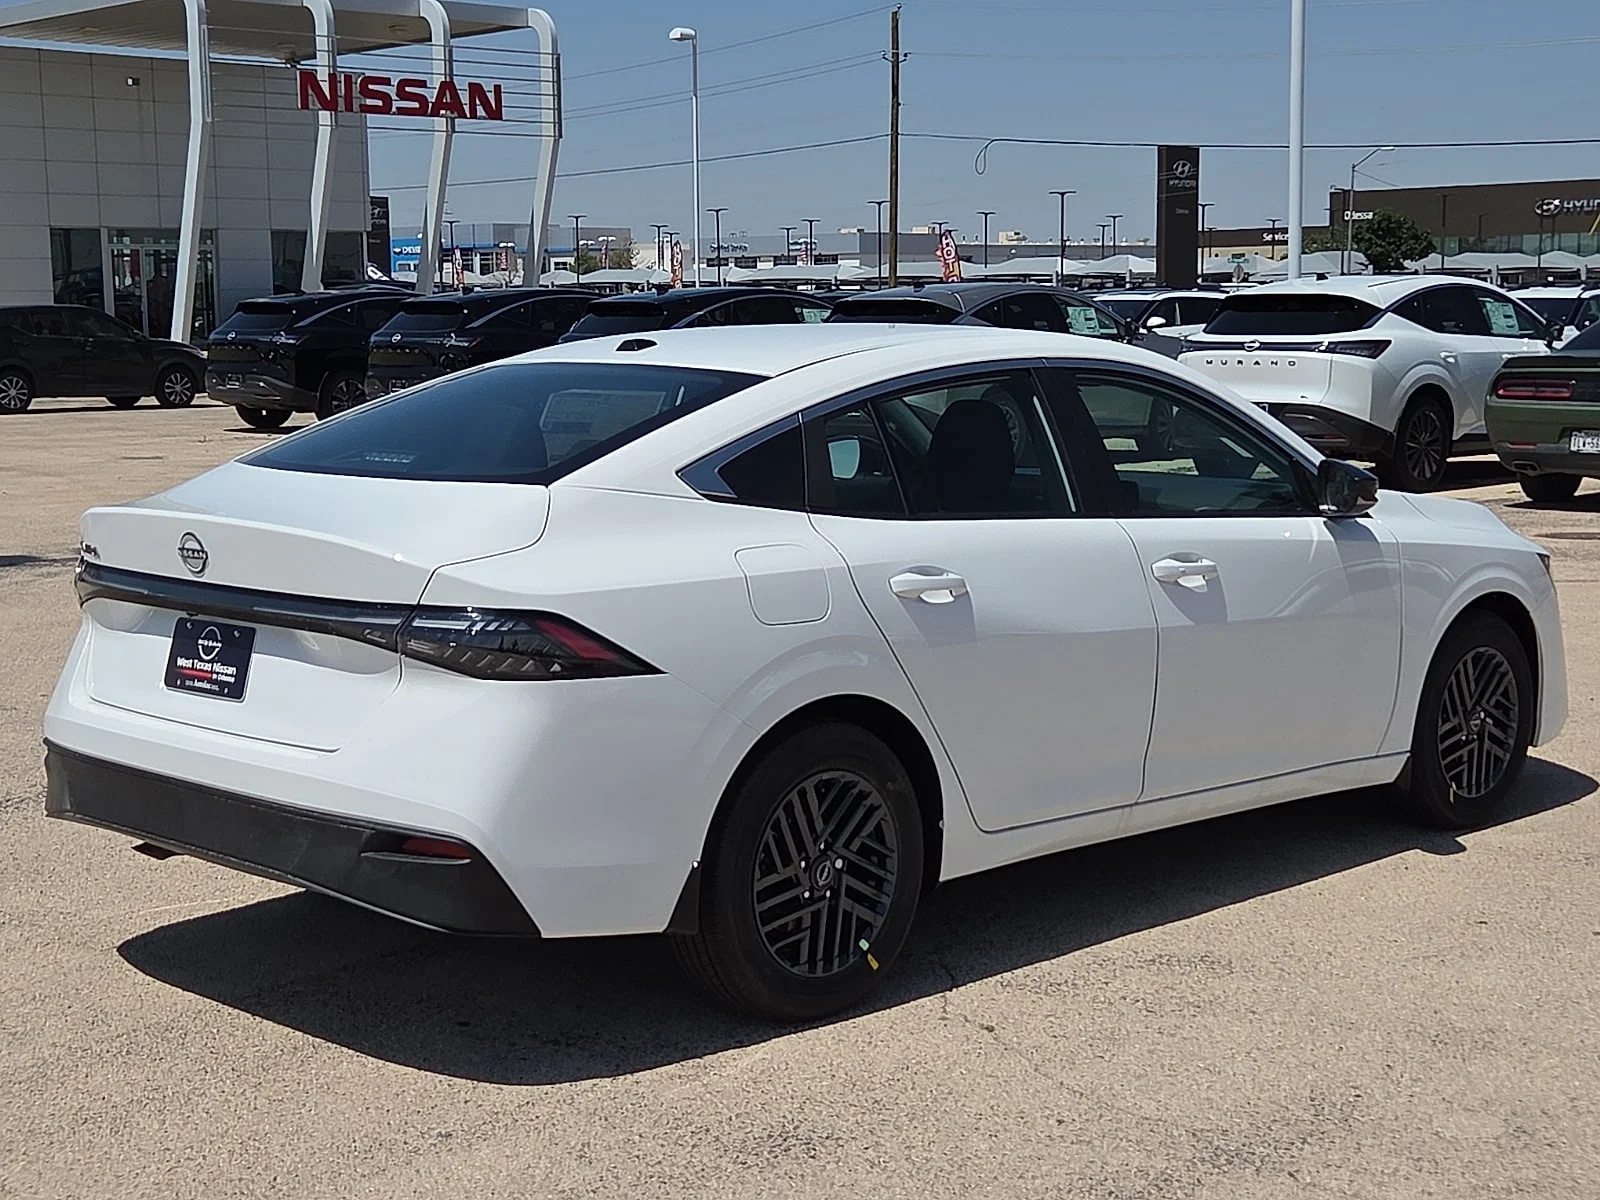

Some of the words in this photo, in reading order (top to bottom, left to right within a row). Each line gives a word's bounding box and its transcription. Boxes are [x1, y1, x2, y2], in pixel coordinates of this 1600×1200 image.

[298, 70, 503, 120] NISSAN
[1206, 358, 1296, 367] MURANO
[177, 657, 192, 668] West
[194, 659, 212, 671] Texas
[213, 663, 236, 675] Nissan
